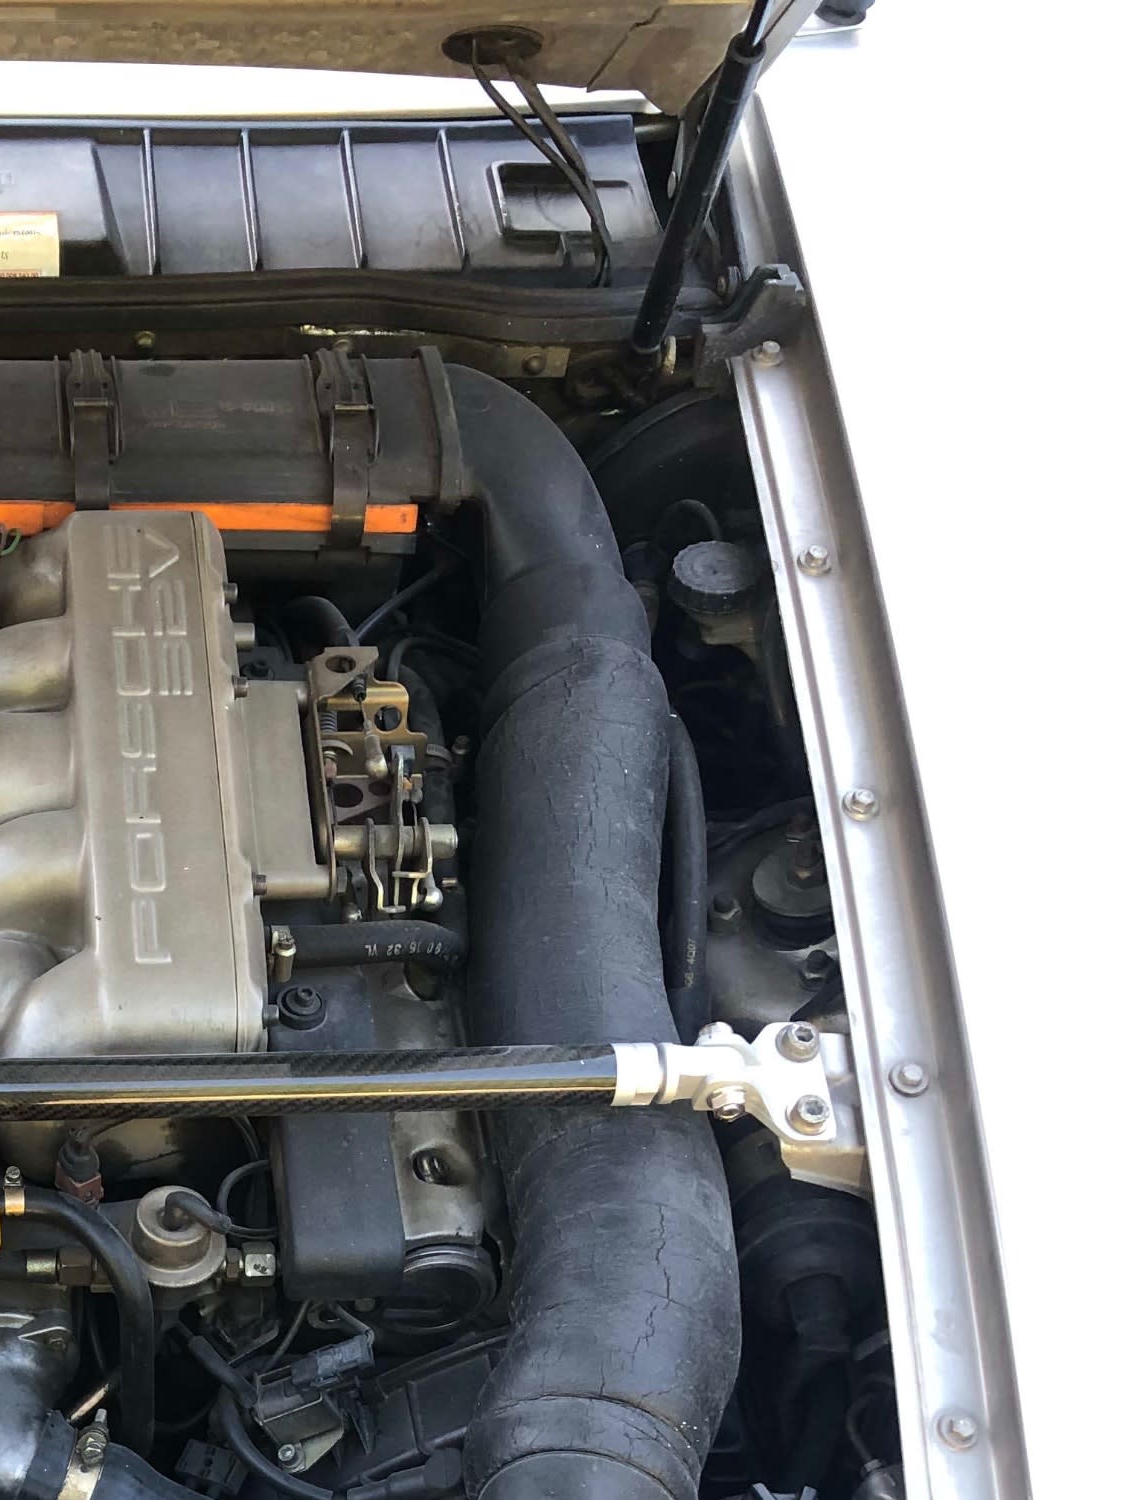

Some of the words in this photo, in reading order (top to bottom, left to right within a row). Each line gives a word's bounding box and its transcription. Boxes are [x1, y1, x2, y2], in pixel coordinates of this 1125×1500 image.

[147, 526, 194, 696] 32V
[102, 524, 172, 965] PORSCHE
[386, 943, 402, 957] 32
